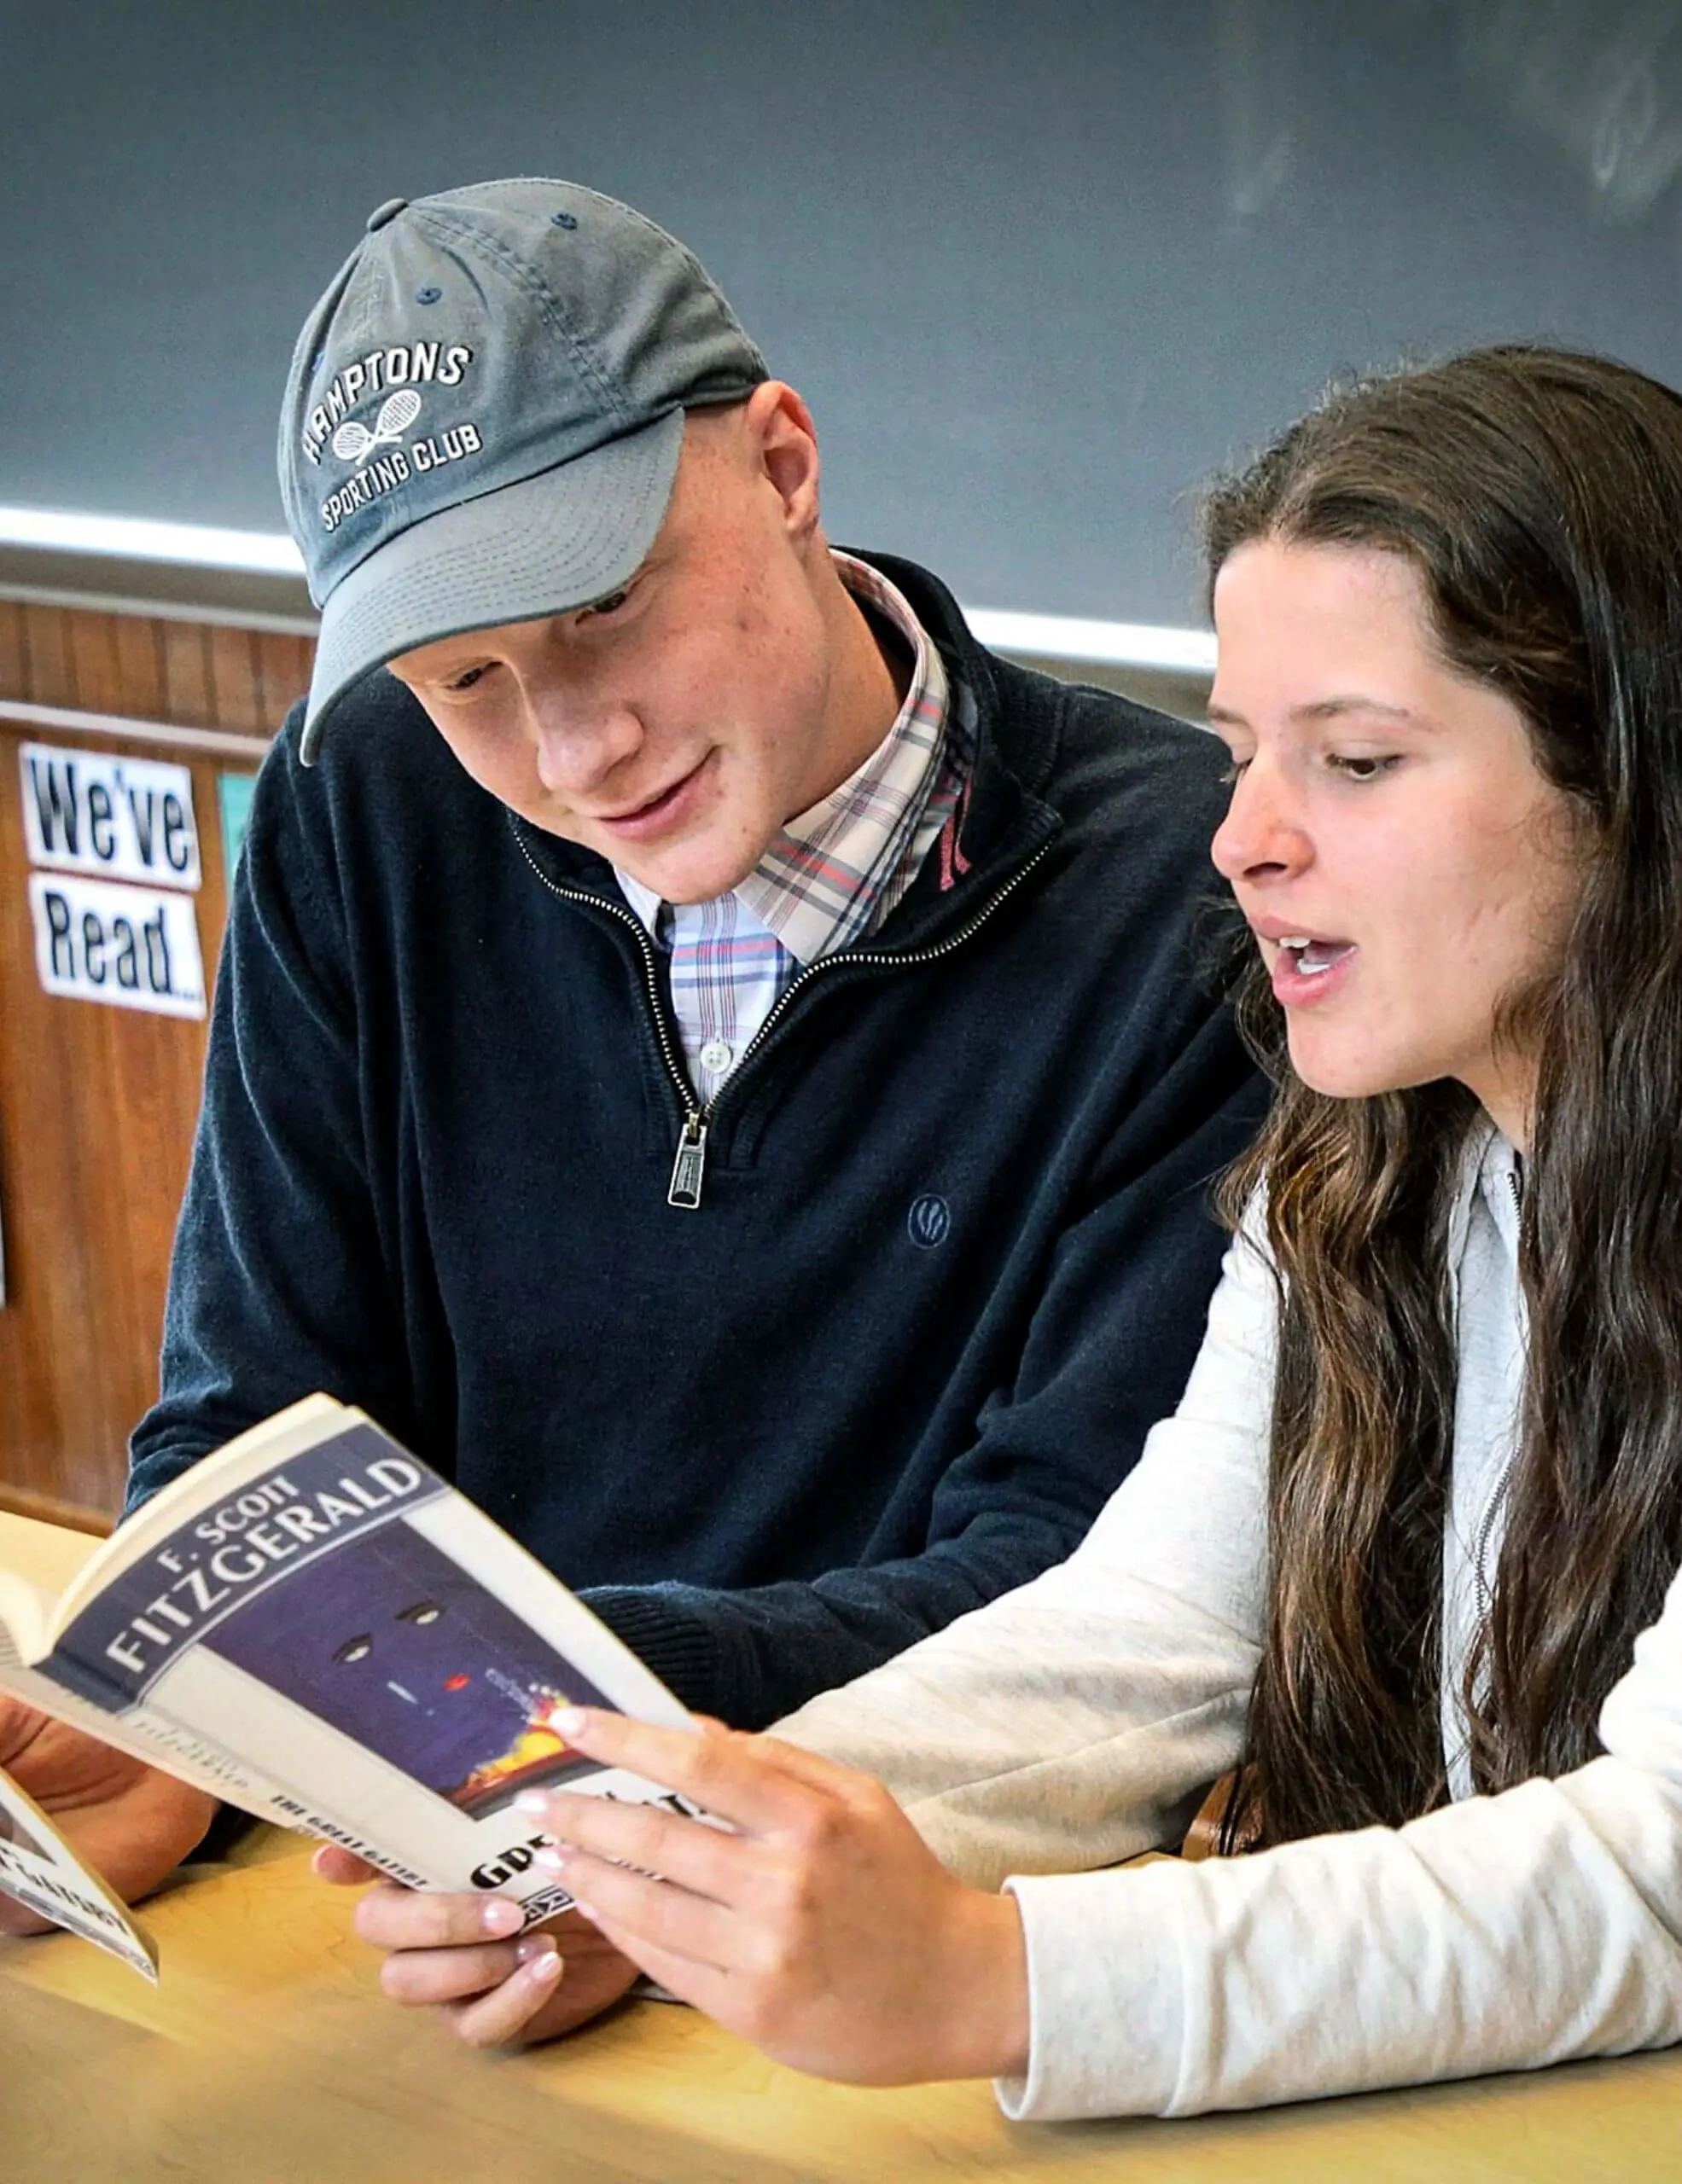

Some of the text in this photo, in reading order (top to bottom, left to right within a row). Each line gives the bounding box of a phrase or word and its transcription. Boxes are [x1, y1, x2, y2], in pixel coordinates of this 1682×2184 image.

[302, 341, 473, 465] HAMPTONS
[320, 424, 483, 532] SPORTING CLUB
[30, 758, 189, 872] We've
[105, 1457, 422, 1674] FITZGERALD
[156, 1474, 300, 1573] F. SCOTT
